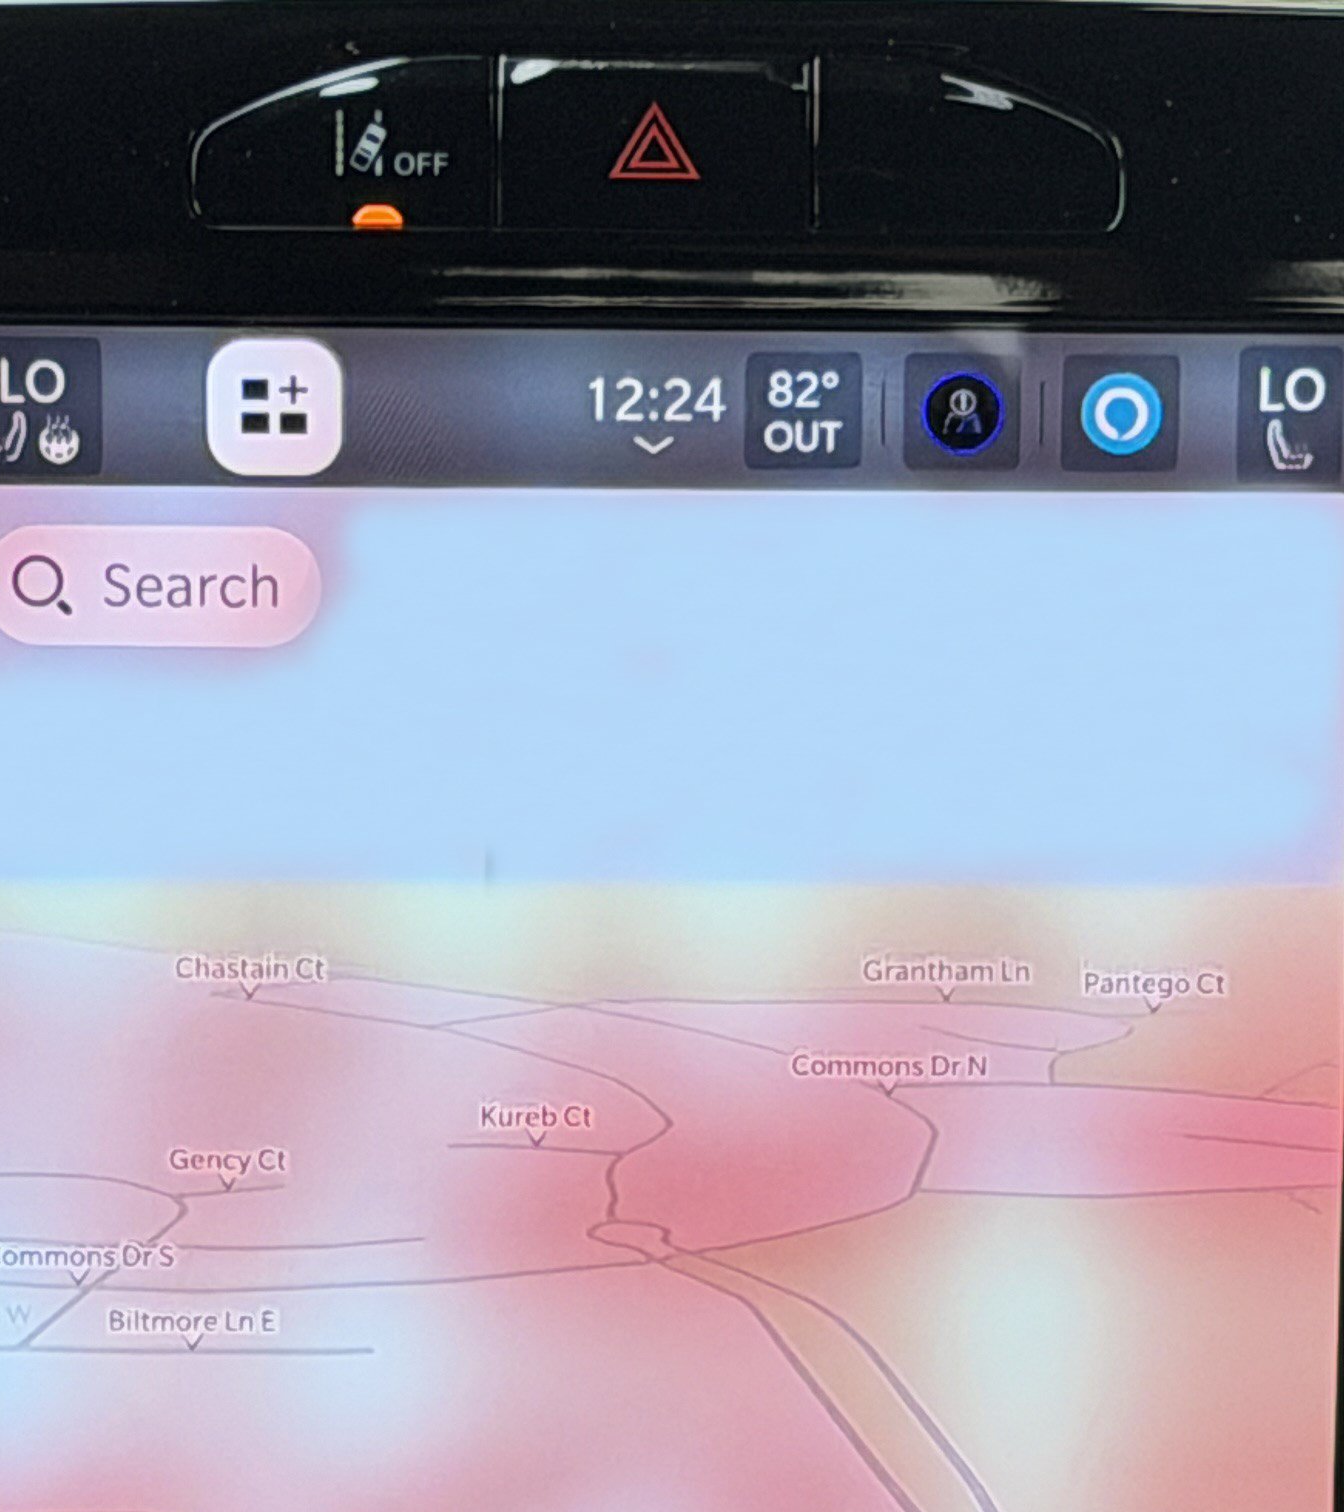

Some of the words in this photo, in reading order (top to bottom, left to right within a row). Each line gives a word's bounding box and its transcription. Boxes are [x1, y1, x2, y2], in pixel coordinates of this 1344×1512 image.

[393, 151, 449, 176] OFF
[588, 377, 726, 424] 12:24
[767, 371, 840, 408] 82°
[1258, 366, 1326, 411] LO
[764, 421, 842, 454] OUT
[103, 562, 280, 610] Search
[175, 957, 289, 981] Chastain
[296, 957, 325, 981] Ct
[863, 960, 993, 984] Grantham
[1002, 960, 1030, 983] Ln
[1084, 973, 1190, 998] Pantego
[1197, 973, 1225, 994] Ct
[792, 1055, 923, 1077] Commons
[930, 1055, 960, 1076] Dr
[968, 1055, 987, 1076] N
[480, 1106, 556, 1128] Kureb
[564, 1106, 591, 1128] Ct
[169, 1149, 250, 1176] Gency
[258, 1149, 286, 1171] Ct
[122, 1246, 153, 1267] Dr
[159, 1246, 174, 1267] S
[6, 1304, 32, 1325] W
[109, 1311, 217, 1332] Biltmore
[225, 1311, 254, 1332] Ln
[261, 1311, 274, 1332] E
